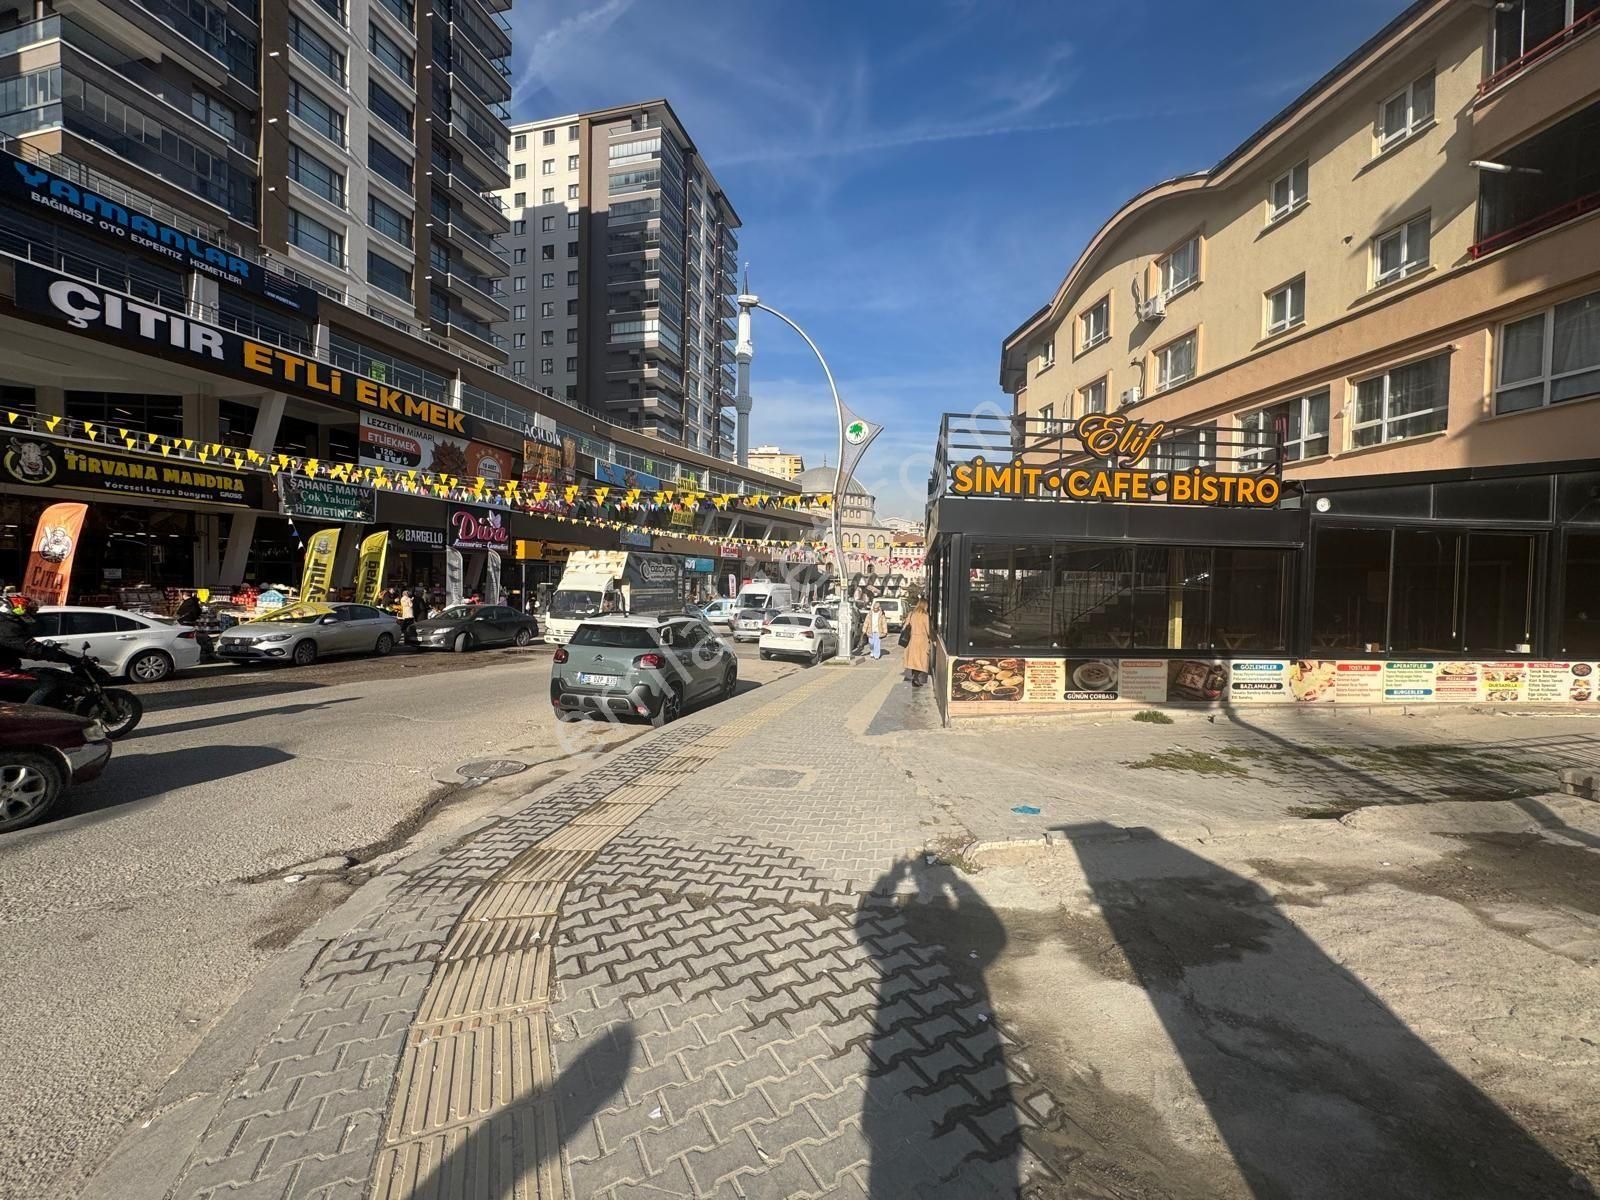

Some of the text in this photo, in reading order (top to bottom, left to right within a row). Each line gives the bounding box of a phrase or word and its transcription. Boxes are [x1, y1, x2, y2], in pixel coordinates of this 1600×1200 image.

[31, 191, 94, 224] BAĞIMSIZ
[99, 220, 125, 237] OTO
[48, 281, 466, 434] ÇITIR ETLİ EKMEK
[367, 416, 405, 435] LEZZETİN
[1078, 415, 1164, 467] Elif
[367, 432, 416, 452] ETLİEKMEK
[64, 454, 246, 492] TİRVANA MANDIRA
[290, 478, 370, 498] ŞAHANE MANAV
[954, 458, 1280, 504] SİMİT CAFE BİSTRO
[300, 491, 320, 503] Çok
[405, 529, 443, 544] BARGELLO
[452, 511, 508, 542] Diva
